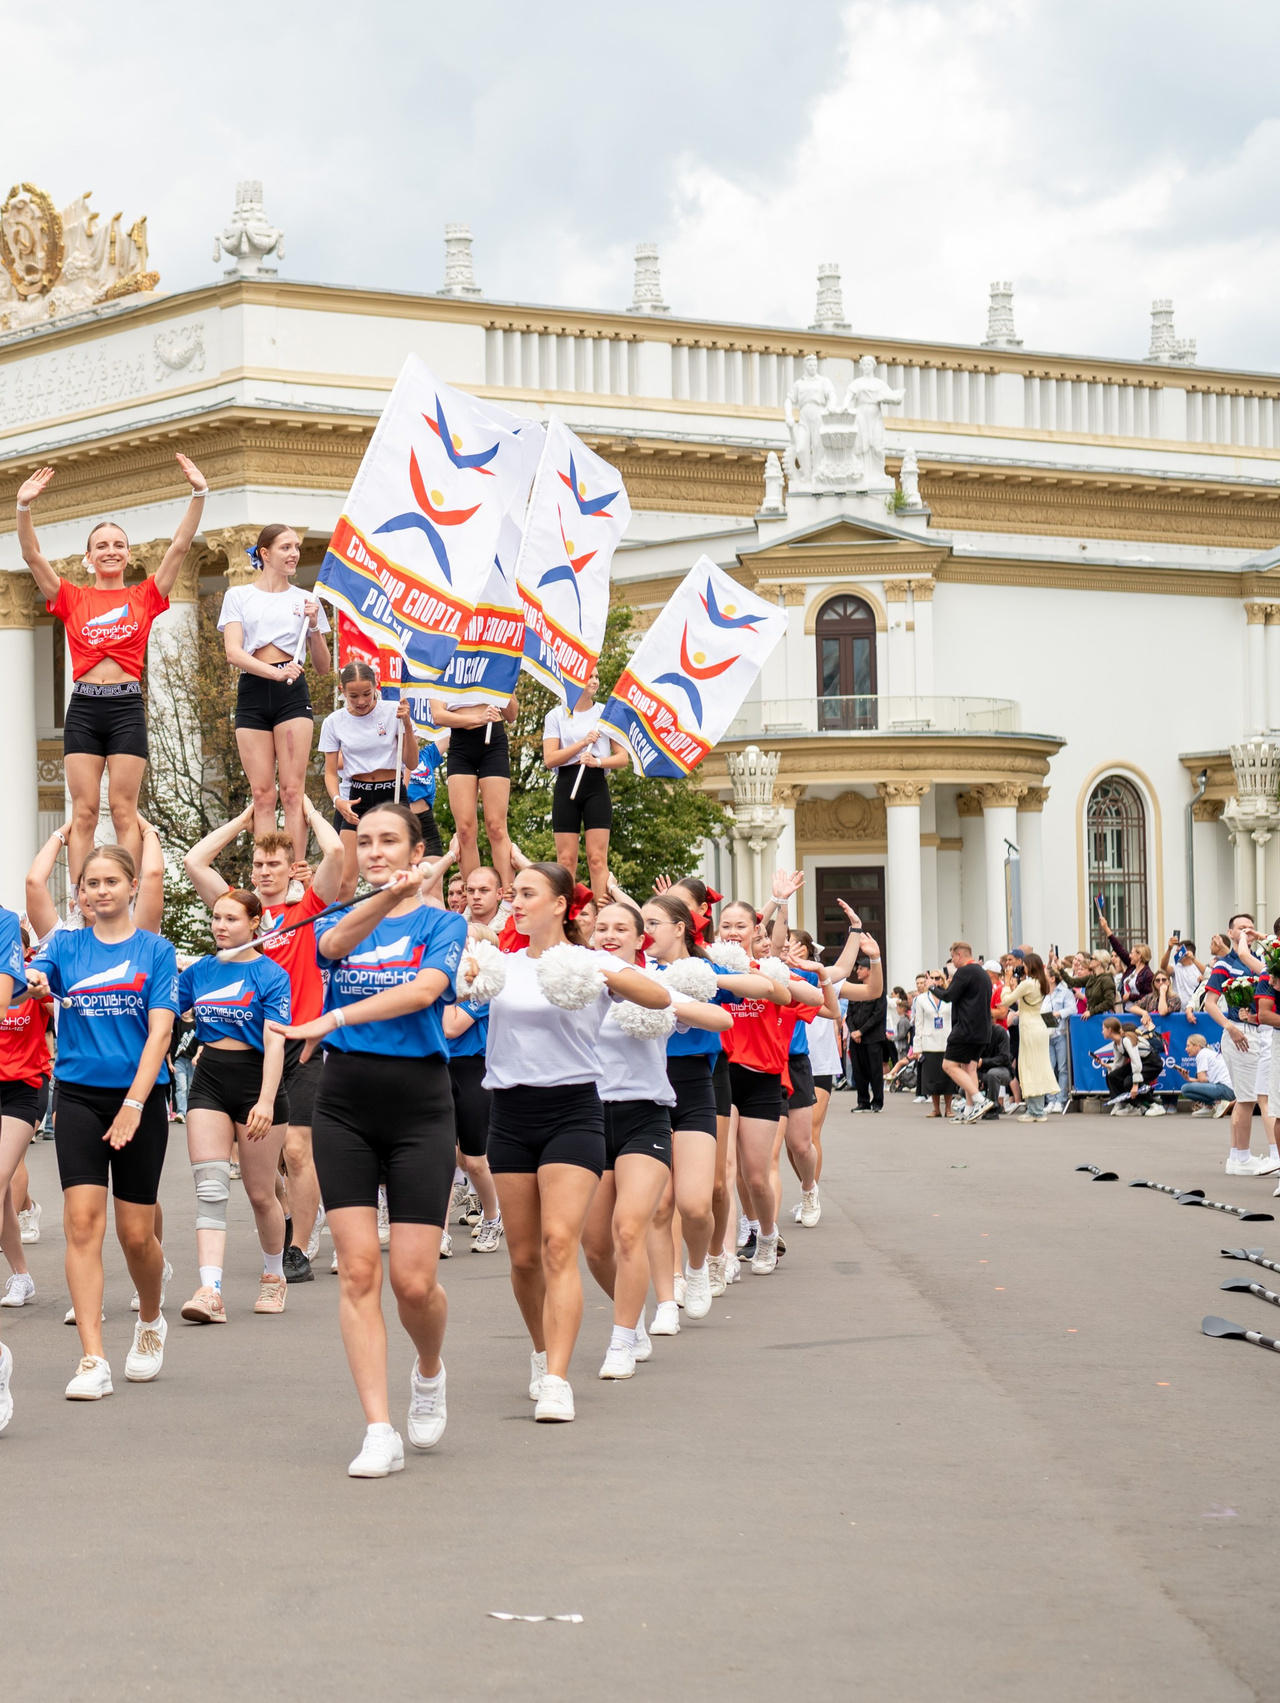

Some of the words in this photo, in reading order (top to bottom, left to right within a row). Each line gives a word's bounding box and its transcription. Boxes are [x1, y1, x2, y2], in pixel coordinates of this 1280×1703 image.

[402, 588, 462, 633] СПОРТА
[552, 637, 589, 680] СПОРТА
[627, 684, 657, 717] СОЮЗ
[351, 780, 374, 790] NIKE
[374, 782, 396, 791] PRO
[334, 970, 418, 984] СПОРТИВНО
[78, 1007, 138, 1017] ШЕСТВИЕ
